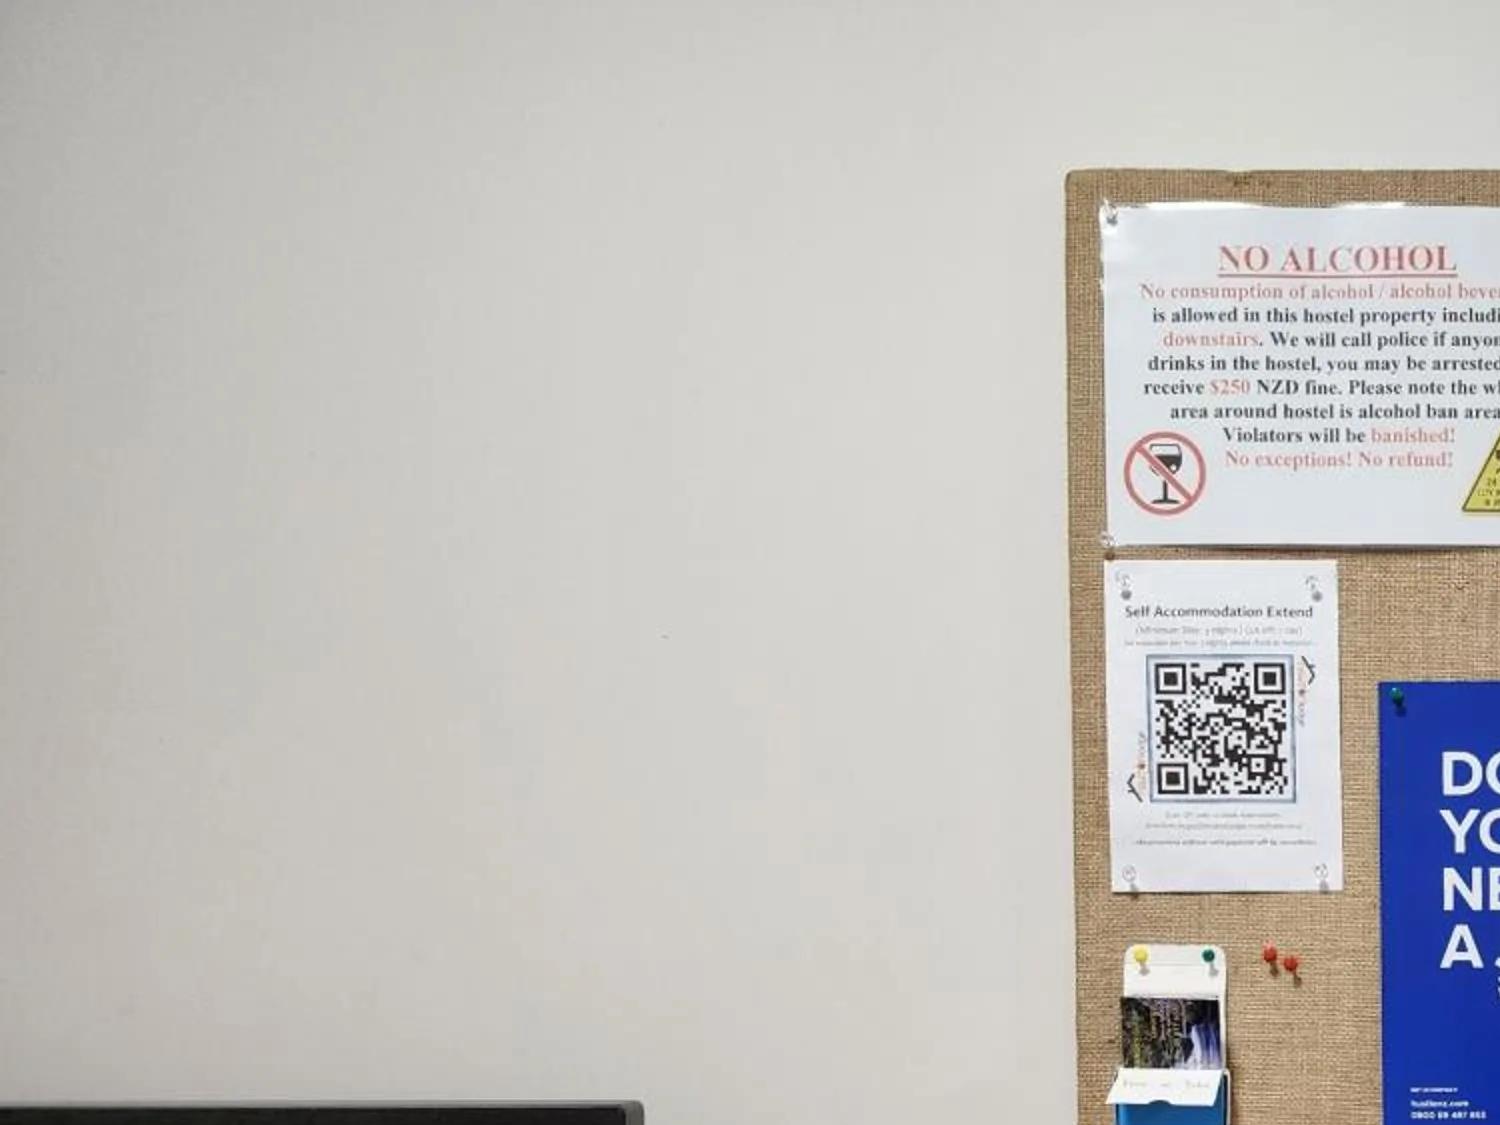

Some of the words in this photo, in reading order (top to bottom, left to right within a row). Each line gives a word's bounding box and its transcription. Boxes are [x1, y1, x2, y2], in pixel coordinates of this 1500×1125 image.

[1219, 245, 1269, 273] NO
[1281, 245, 1458, 273] ALCOHOL
[1140, 284, 1166, 299] No
[1170, 285, 1286, 301] consumption
[1289, 284, 1308, 299] of
[1311, 284, 1373, 299] alcohol
[1390, 284, 1452, 299] alcohol
[1153, 308, 1166, 323] is
[1171, 308, 1239, 323] allowed
[1244, 308, 1260, 323] in
[1266, 308, 1298, 324] this
[1303, 308, 1355, 324] hostel
[1360, 308, 1437, 325] property
[1126, 606, 1149, 618] Self
[1154, 606, 1262, 618] Accommodation
[1267, 606, 1313, 618] Extend
[1440, 924, 1483, 968] A
